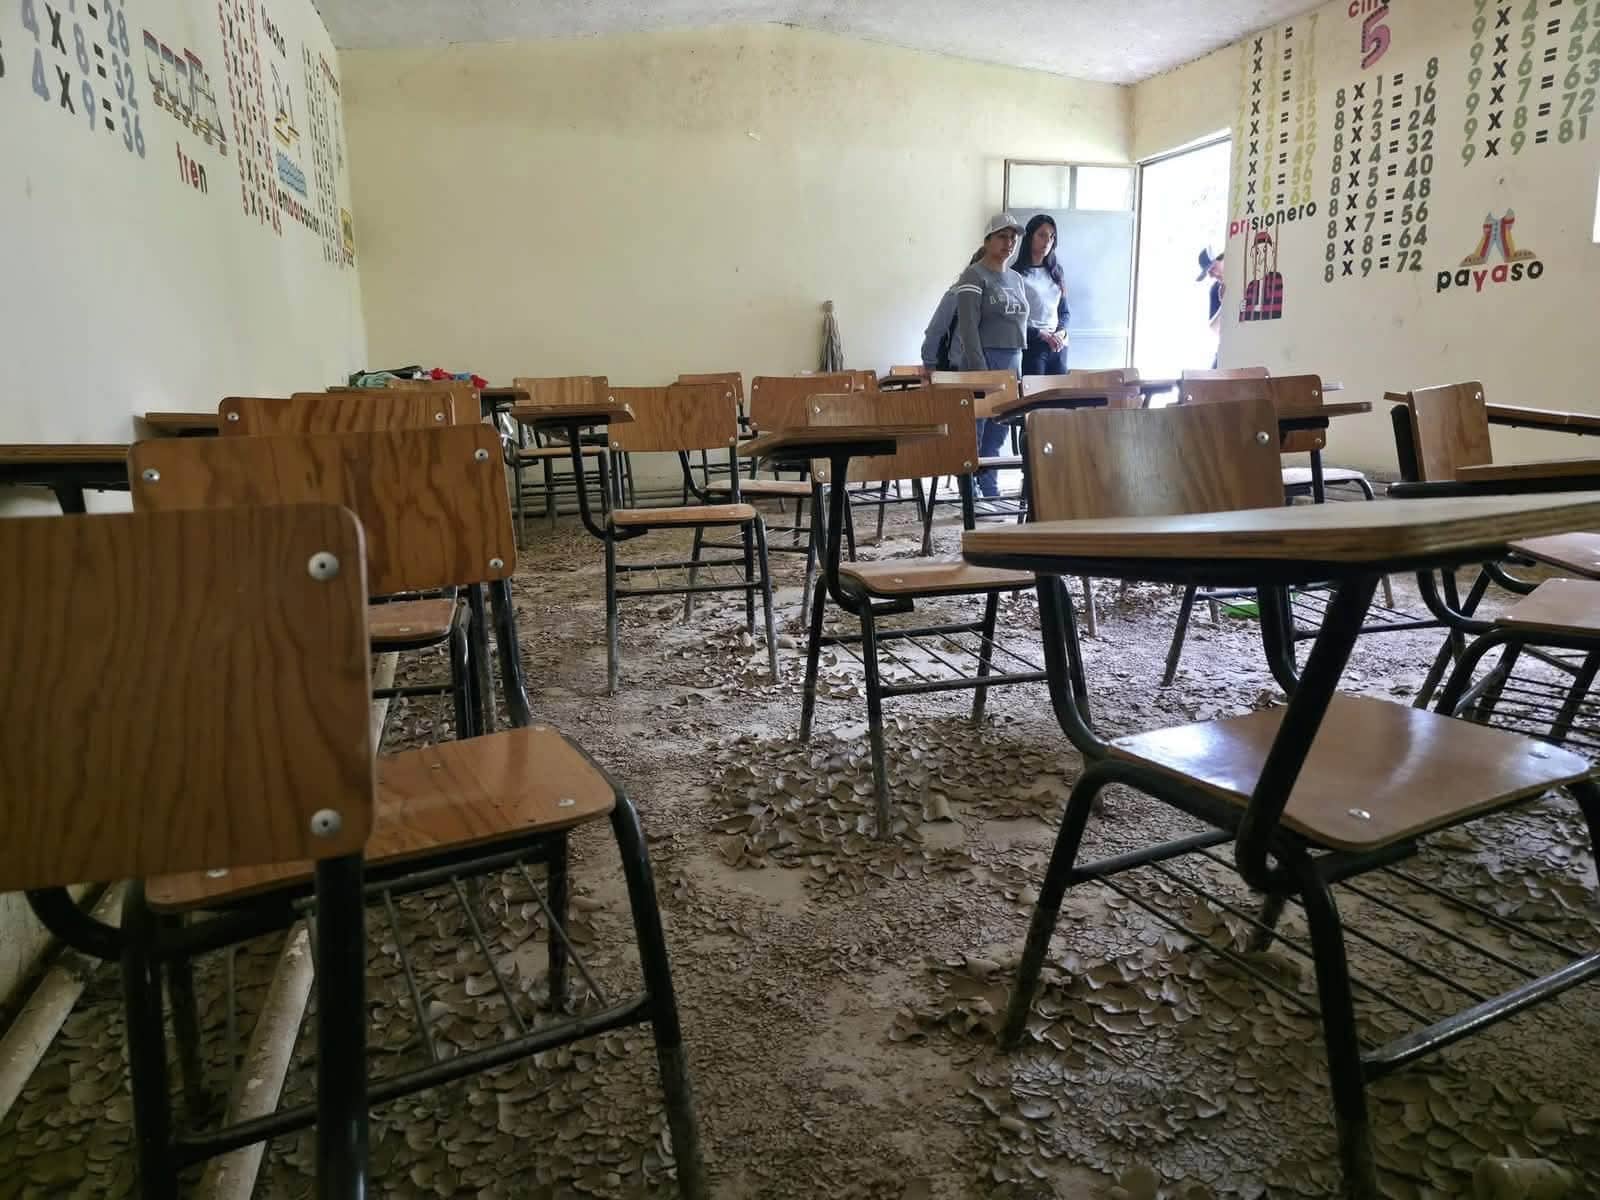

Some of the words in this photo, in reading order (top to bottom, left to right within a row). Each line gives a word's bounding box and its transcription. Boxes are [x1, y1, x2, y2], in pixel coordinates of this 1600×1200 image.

[1361, 6, 1391, 70] 5
[1470, 41, 1485, 67] 9
[1520, 23, 1536, 49] 5
[1472, 16, 1487, 41] 9
[73, 22, 90, 76] 8
[111, 51, 138, 111] 32
[1336, 87, 1346, 109] 8
[1375, 74, 1383, 97] 1
[1426, 56, 1439, 80] 8
[1466, 91, 1482, 117] 9
[1517, 77, 1532, 104] 7
[1563, 58, 1600, 90] 63
[1468, 66, 1483, 92] 9
[1517, 51, 1533, 77] 6
[32, 47, 51, 102] 4
[82, 79, 96, 132] 9
[121, 105, 146, 160] 36
[1334, 110, 1345, 131] 8
[1372, 98, 1384, 120] 2
[1415, 80, 1437, 108] 16
[1464, 116, 1479, 143] 9
[1512, 105, 1528, 130] 8
[1560, 88, 1596, 119] 72
[1333, 132, 1344, 153] 8
[1370, 121, 1382, 143] 3
[1408, 103, 1436, 132] 24
[1461, 143, 1476, 168] 9
[1510, 130, 1526, 156] 9
[1558, 114, 1588, 144] 81
[176, 141, 208, 194] tren
[1330, 176, 1341, 197] 8
[1367, 165, 1379, 188] 5
[1404, 153, 1433, 178] 40
[1332, 154, 1342, 175] 8
[1368, 142, 1381, 163] 4
[1406, 129, 1434, 155] 32
[1328, 197, 1339, 218] 8
[1365, 188, 1378, 210] 6
[1402, 176, 1431, 201] 48
[1229, 201, 1317, 240] prisionero
[1325, 241, 1336, 263] 8
[1362, 234, 1374, 256] 8
[1398, 223, 1428, 249] 64
[1327, 219, 1338, 241] 8
[1364, 211, 1376, 233] 7
[1400, 201, 1429, 227] 56
[1324, 263, 1335, 283] 8
[1361, 256, 1373, 279] 9
[1396, 249, 1424, 273] 72
[1436, 260, 1544, 293] payaso
